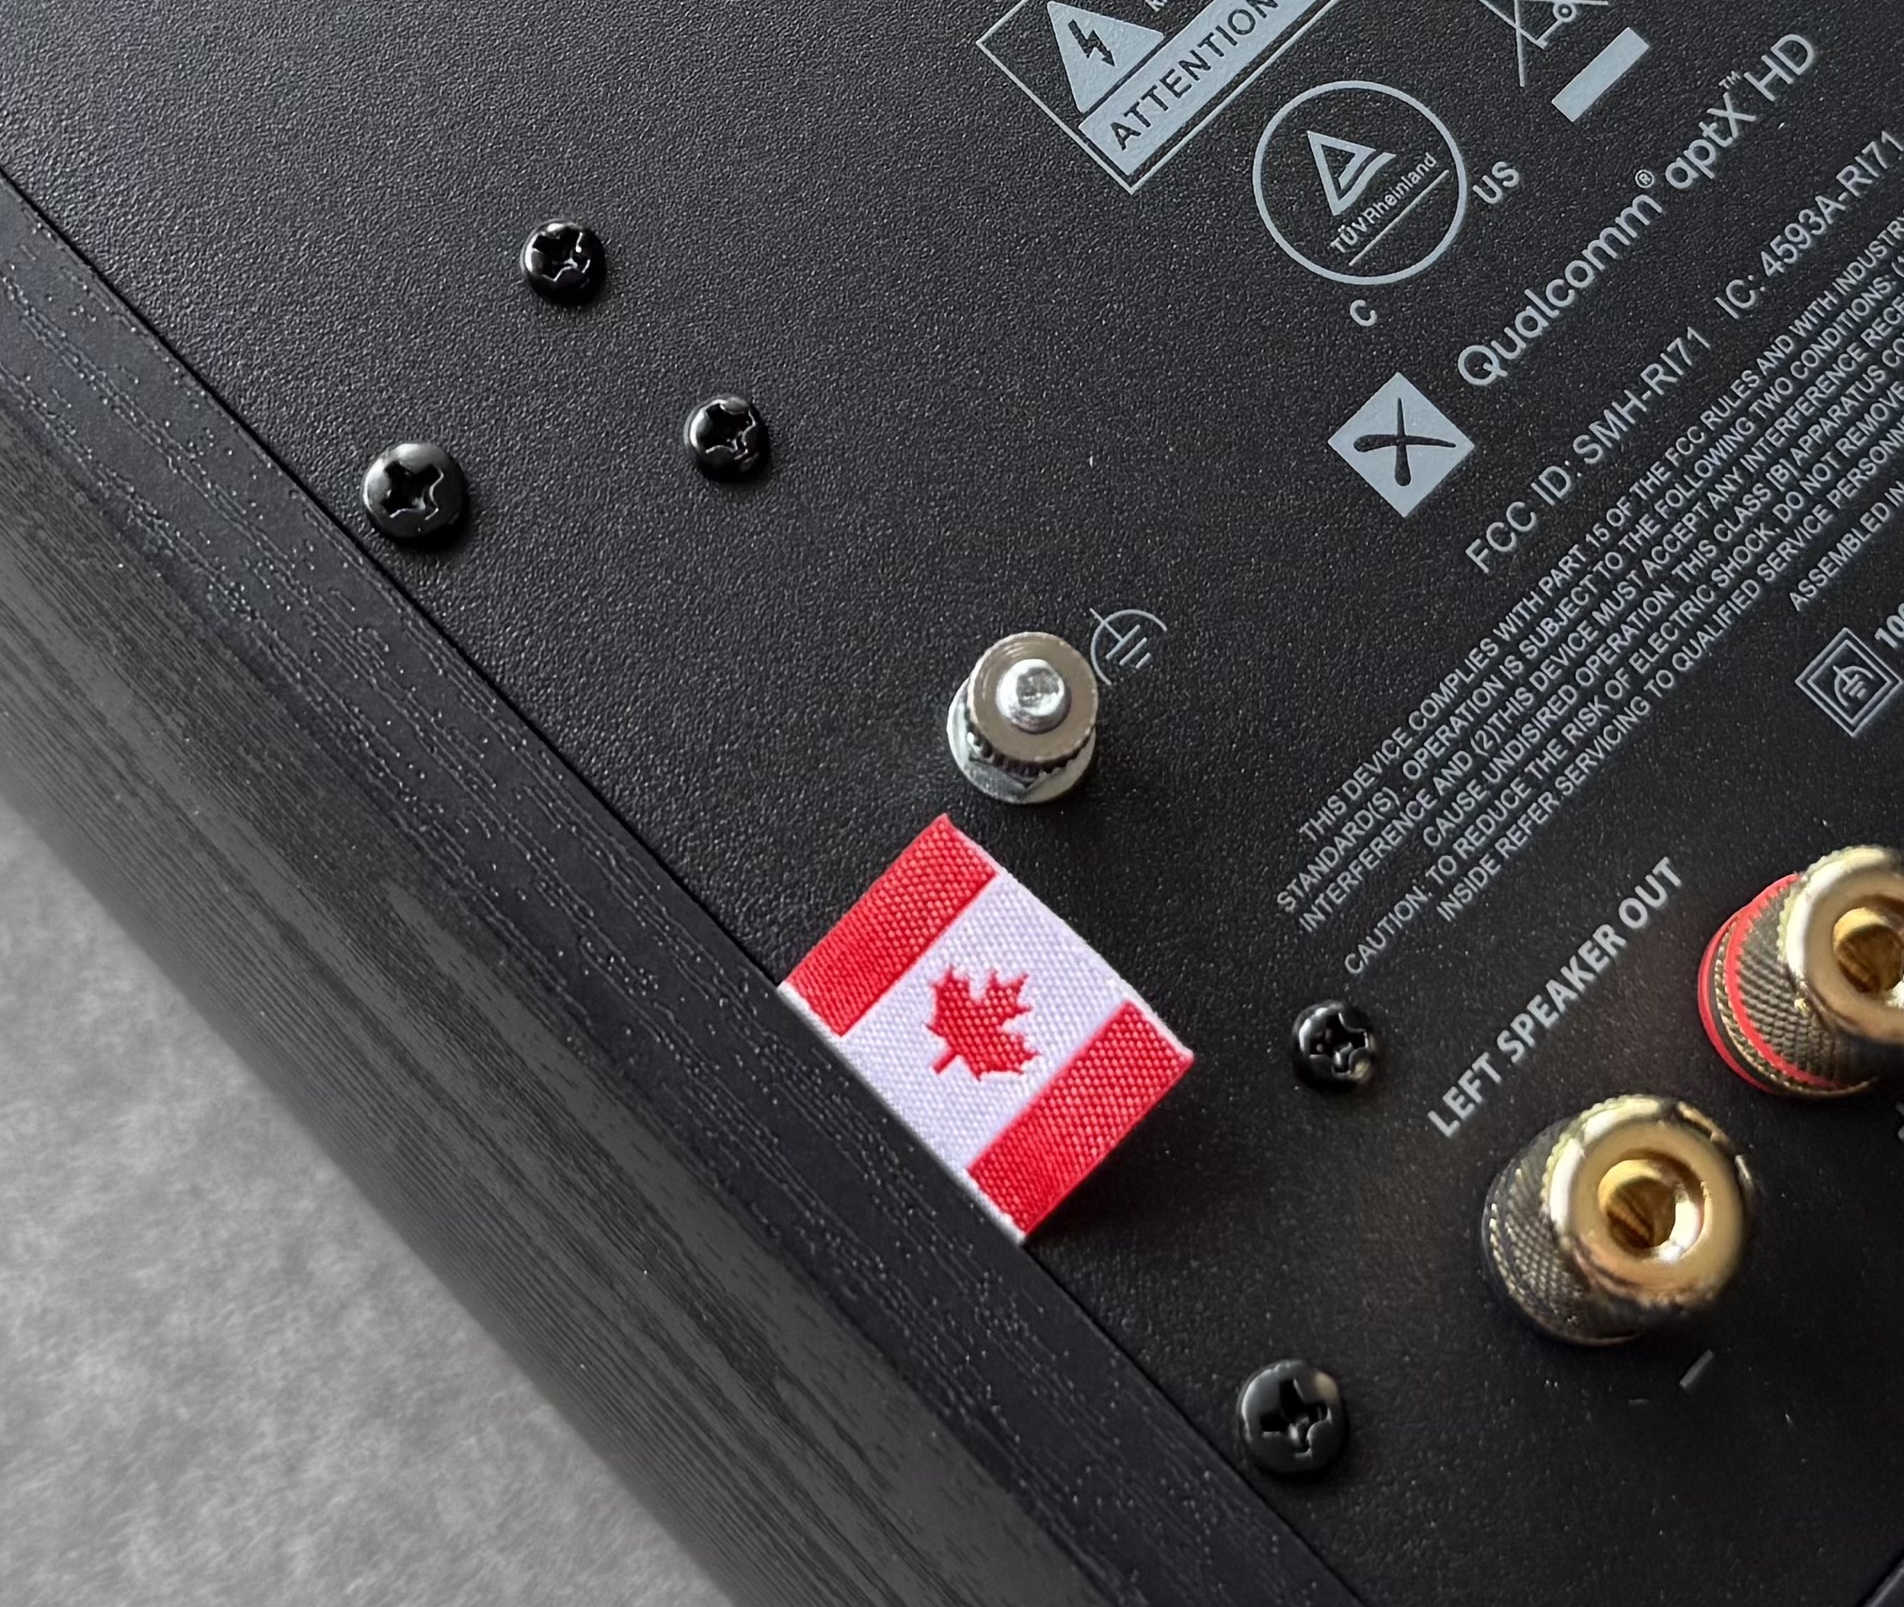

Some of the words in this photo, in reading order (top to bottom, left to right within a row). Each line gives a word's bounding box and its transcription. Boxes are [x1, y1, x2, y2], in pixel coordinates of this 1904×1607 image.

[1348, 298, 1378, 327] C
[1464, 500, 1537, 574] FCC
[1529, 459, 1582, 506] ID:
[1571, 325, 1711, 464] SMH-RI71
[1713, 273, 1766, 320] IC:
[1759, 130, 1904, 276] 4593A-RI71
[1471, 160, 1520, 204] US
[1276, 785, 1401, 912] STANDARD(S)
[1401, 673, 1505, 780] OPERATION
[1498, 654, 1524, 681] IS
[1517, 573, 1598, 660] SUBJECT
[1593, 550, 1624, 580] TO
[1618, 513, 1661, 553] THE
[1654, 416, 1756, 519] FOLLOWING
[1749, 376, 1794, 419] TWO
[1789, 274, 1897, 379] CONDITIONS:
[1298, 794, 1347, 842] THIS
[1340, 725, 1413, 801] DEVICE
[1407, 637, 1499, 731] COMPLIES
[1492, 590, 1545, 641] WITH
[1537, 543, 1587, 597] PART
[1584, 521, 1611, 548] 15
[1605, 495, 1632, 527] OF
[1629, 460, 1672, 500] THE
[1664, 425, 1706, 468] FCC
[1699, 368, 1761, 431] RULES
[1755, 334, 1795, 376] AND
[1788, 289, 1839, 337] WITH
[1298, 787, 1438, 933] INTERFERENCE
[1432, 749, 1473, 796] AND
[1529, 620, 1599, 692] DEVICE
[1592, 570, 1644, 627] MUST
[1640, 502, 1709, 578] ACCEPT
[1706, 466, 1744, 510] ANY
[1740, 341, 1869, 473] INTERFERENCE
[1343, 884, 1433, 974] CAUTION:
[1424, 854, 1457, 885] TO
[1452, 776, 1532, 860] REDUCE
[1524, 737, 1568, 780] THE
[1561, 694, 1610, 746] RISK
[1603, 667, 1630, 700] OF
[1628, 583, 1716, 674] ELECTRIC
[1772, 490, 1805, 524] DO
[1799, 451, 1841, 496] NOT
[1422, 778, 1491, 847] CAUSE
[1480, 684, 1578, 784] UNDISIRED
[1671, 538, 1718, 582] THIS
[1712, 481, 1772, 543] CLASS
[1789, 364, 1887, 466] APPARATUS
[1435, 853, 1501, 922] INSIDE
[1493, 790, 1560, 859] REFER
[1553, 695, 1650, 796] SERVICING
[1643, 668, 1675, 698] TO
[1671, 578, 1761, 672] QUALIFIED
[1756, 503, 1834, 582] SERVICE
[1788, 501, 1891, 611] ASSEMBLED
[1426, 1051, 1502, 1137] LEFT
[1496, 923, 1626, 1063] SPEAKER
[1617, 856, 1682, 930] OUT
